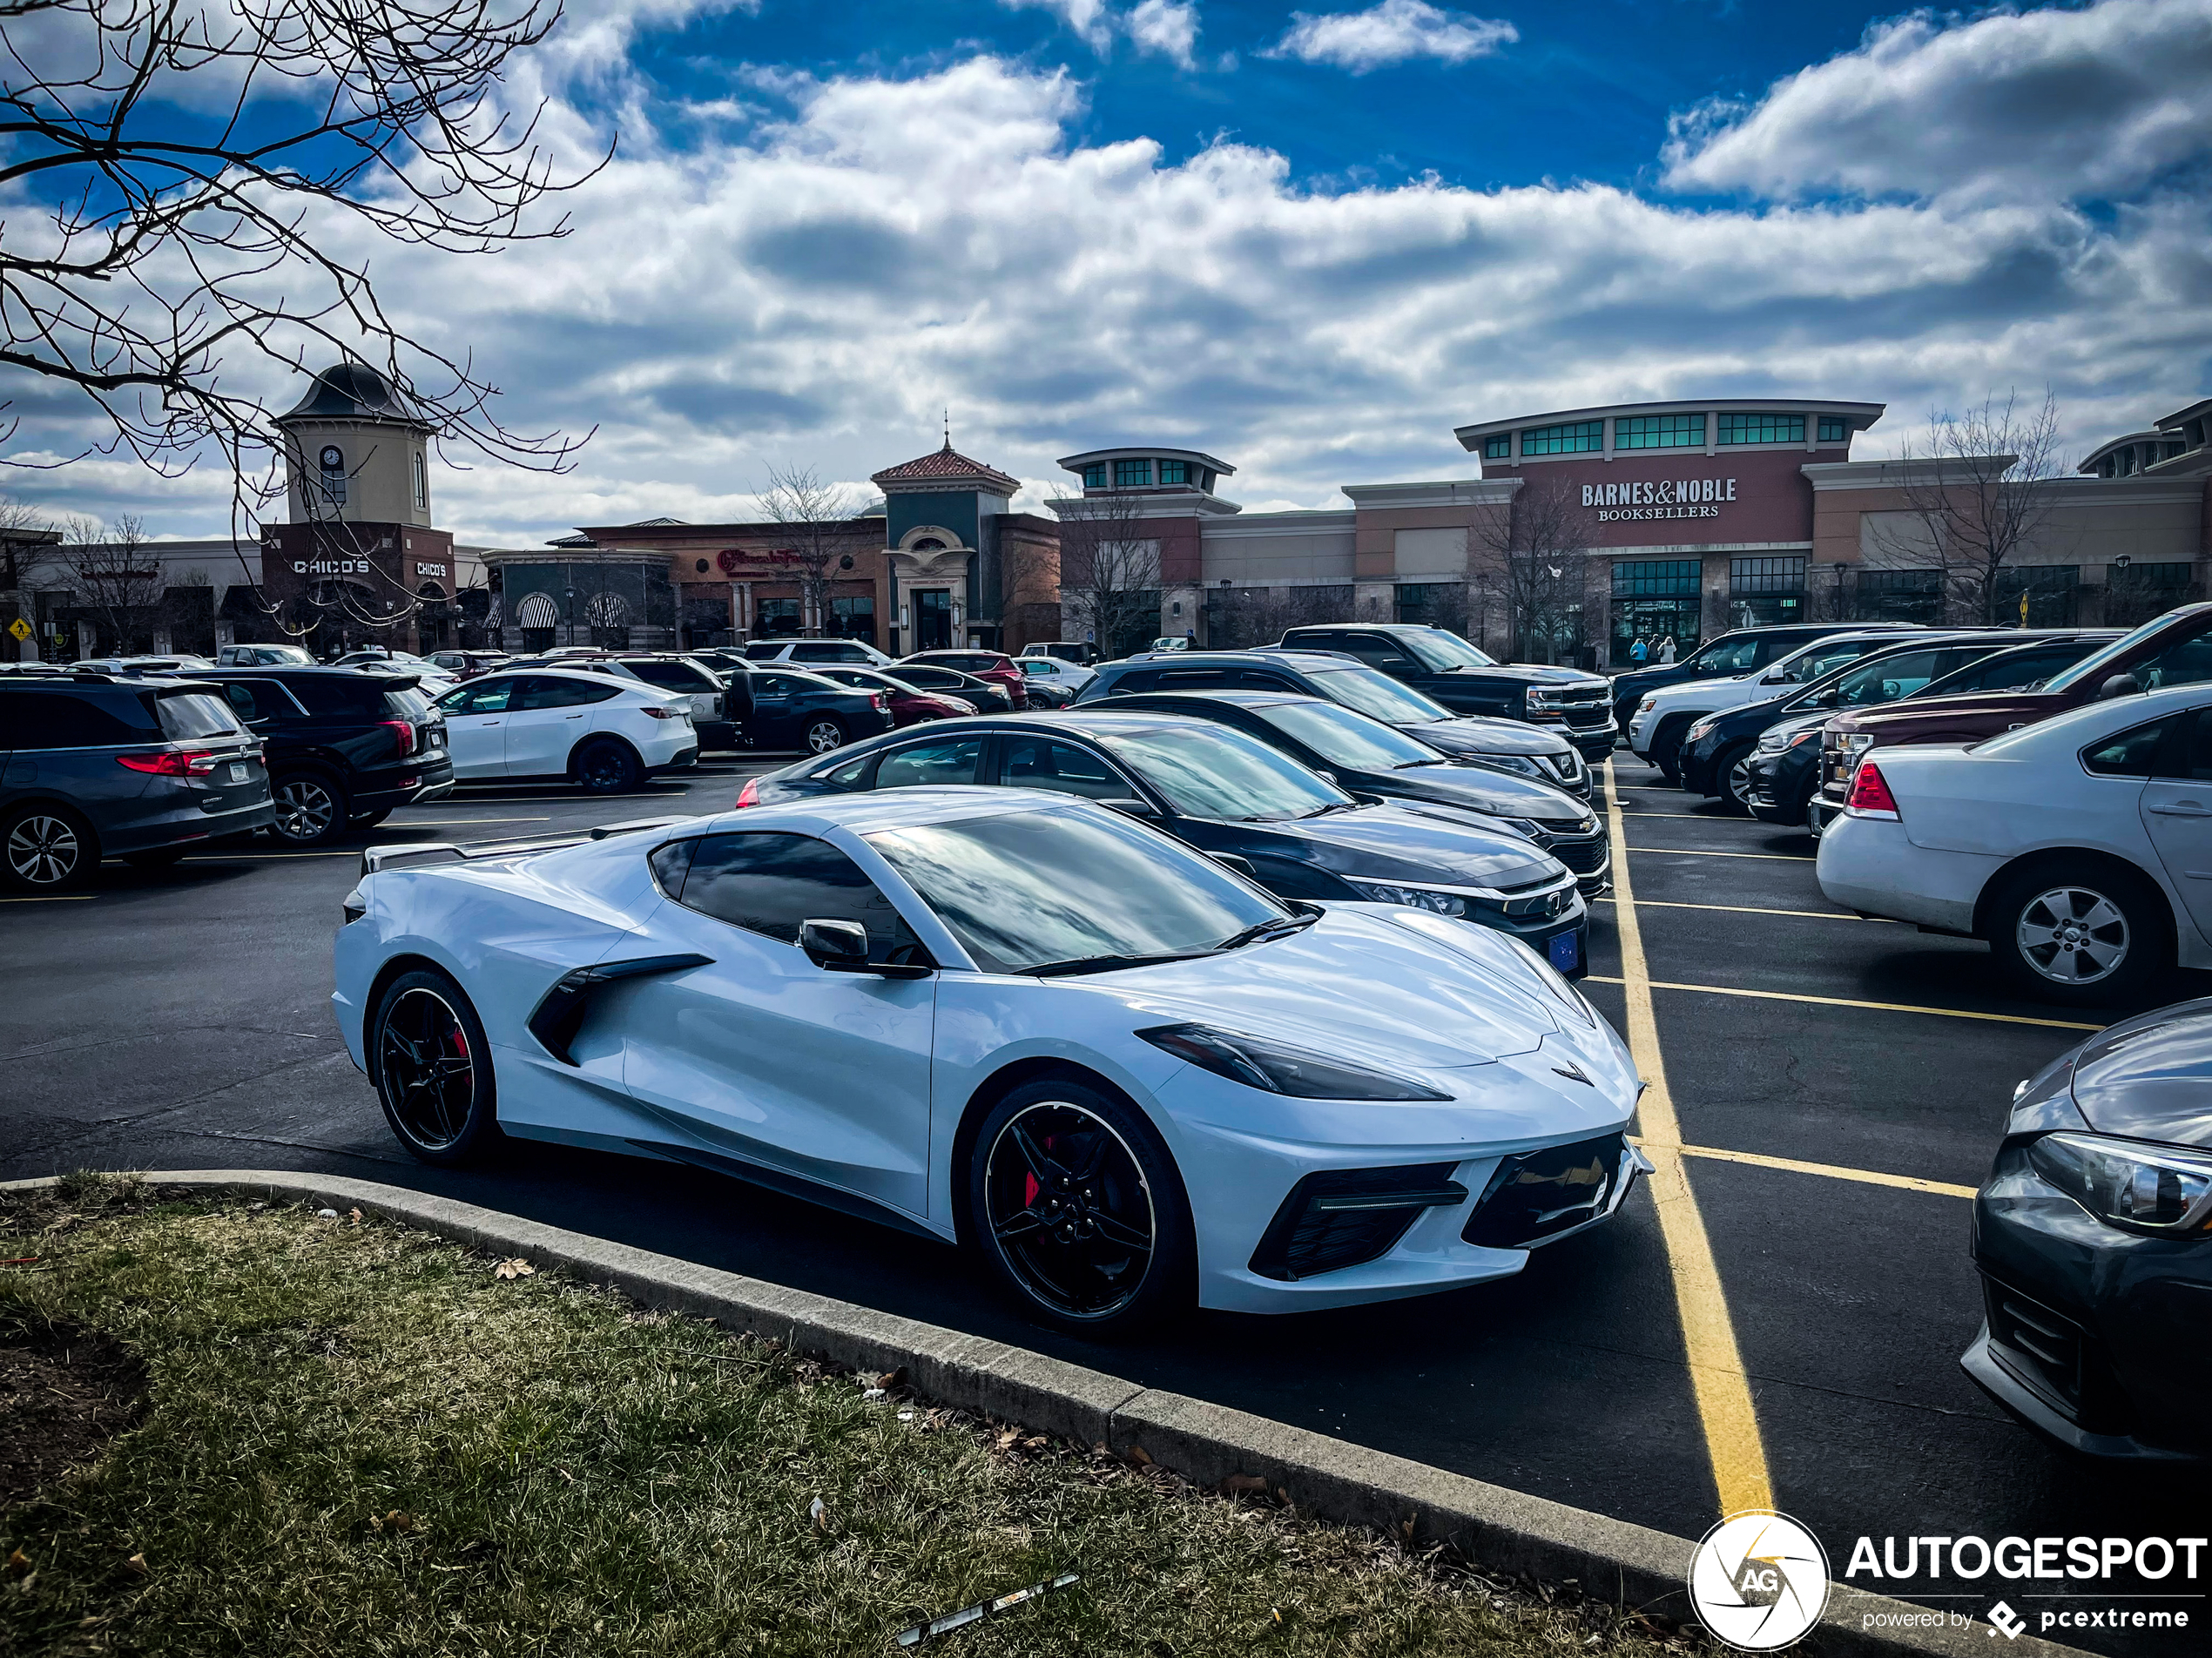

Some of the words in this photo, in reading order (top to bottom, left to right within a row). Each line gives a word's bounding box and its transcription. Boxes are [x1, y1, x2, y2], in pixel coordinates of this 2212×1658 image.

[1598, 505, 1719, 522] BOOKSELLERS
[293, 560, 369, 574] CHICO'S
[417, 562, 447, 577] CHICO'S
